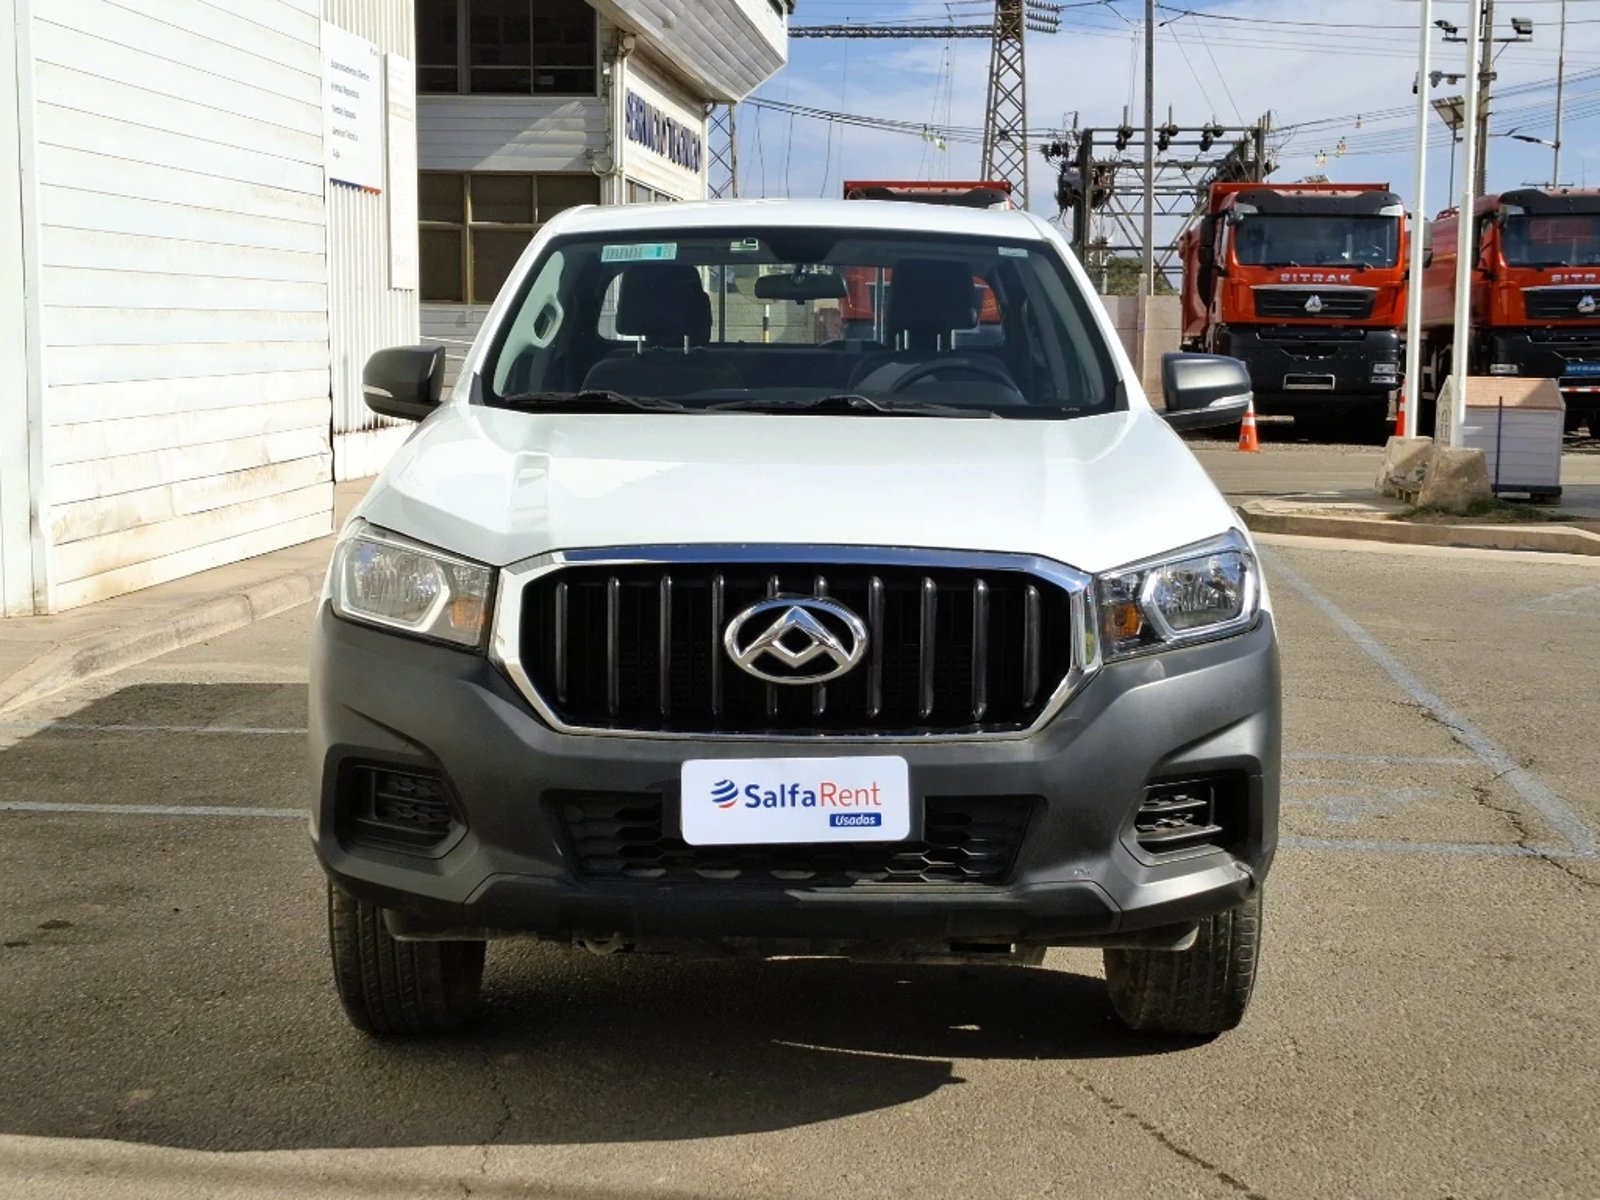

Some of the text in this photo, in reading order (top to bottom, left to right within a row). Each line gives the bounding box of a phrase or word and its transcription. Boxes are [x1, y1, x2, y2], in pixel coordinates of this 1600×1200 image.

[1280, 273, 1351, 282] SITRAK
[1551, 274, 1600, 282] SITR
[744, 781, 882, 808] SalfaRent
[835, 814, 876, 826] Usados
